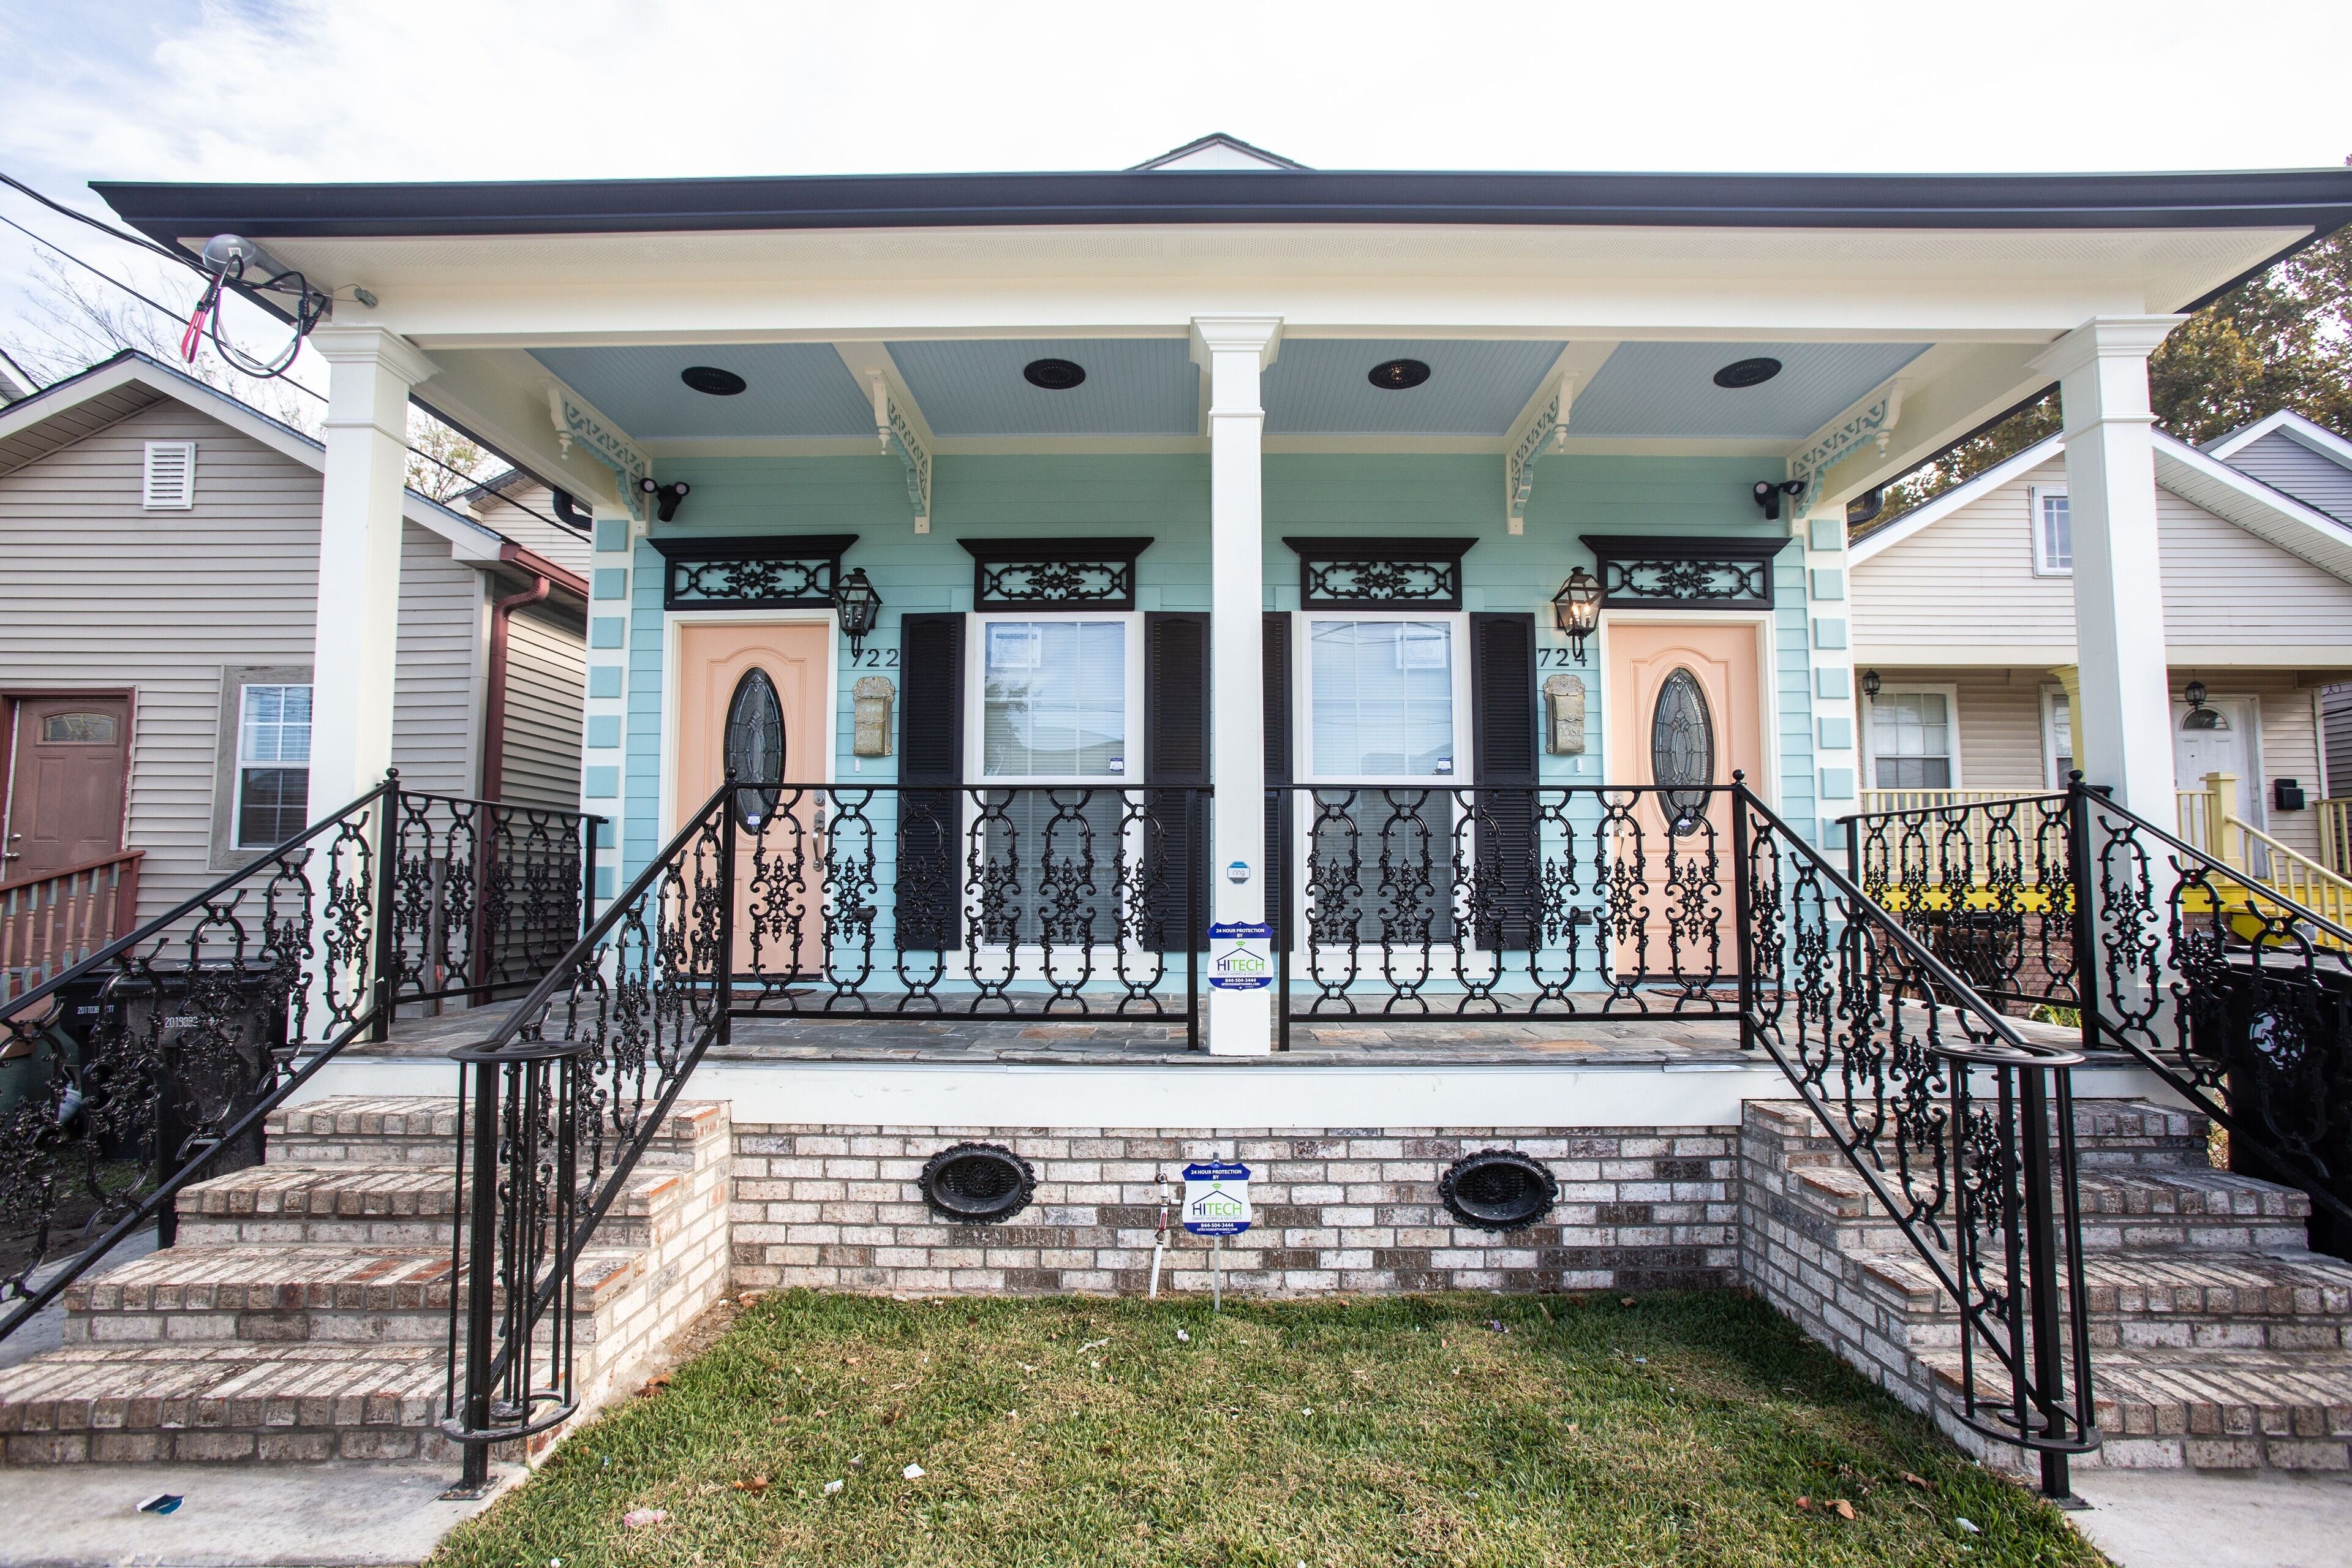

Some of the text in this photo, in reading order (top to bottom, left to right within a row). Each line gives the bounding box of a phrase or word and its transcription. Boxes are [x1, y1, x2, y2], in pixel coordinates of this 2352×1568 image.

[852, 649, 899, 667] 722
[1538, 648, 1588, 667] 724
[1217, 960, 1264, 971] HITECH
[1193, 1203, 1242, 1215] HITECH
